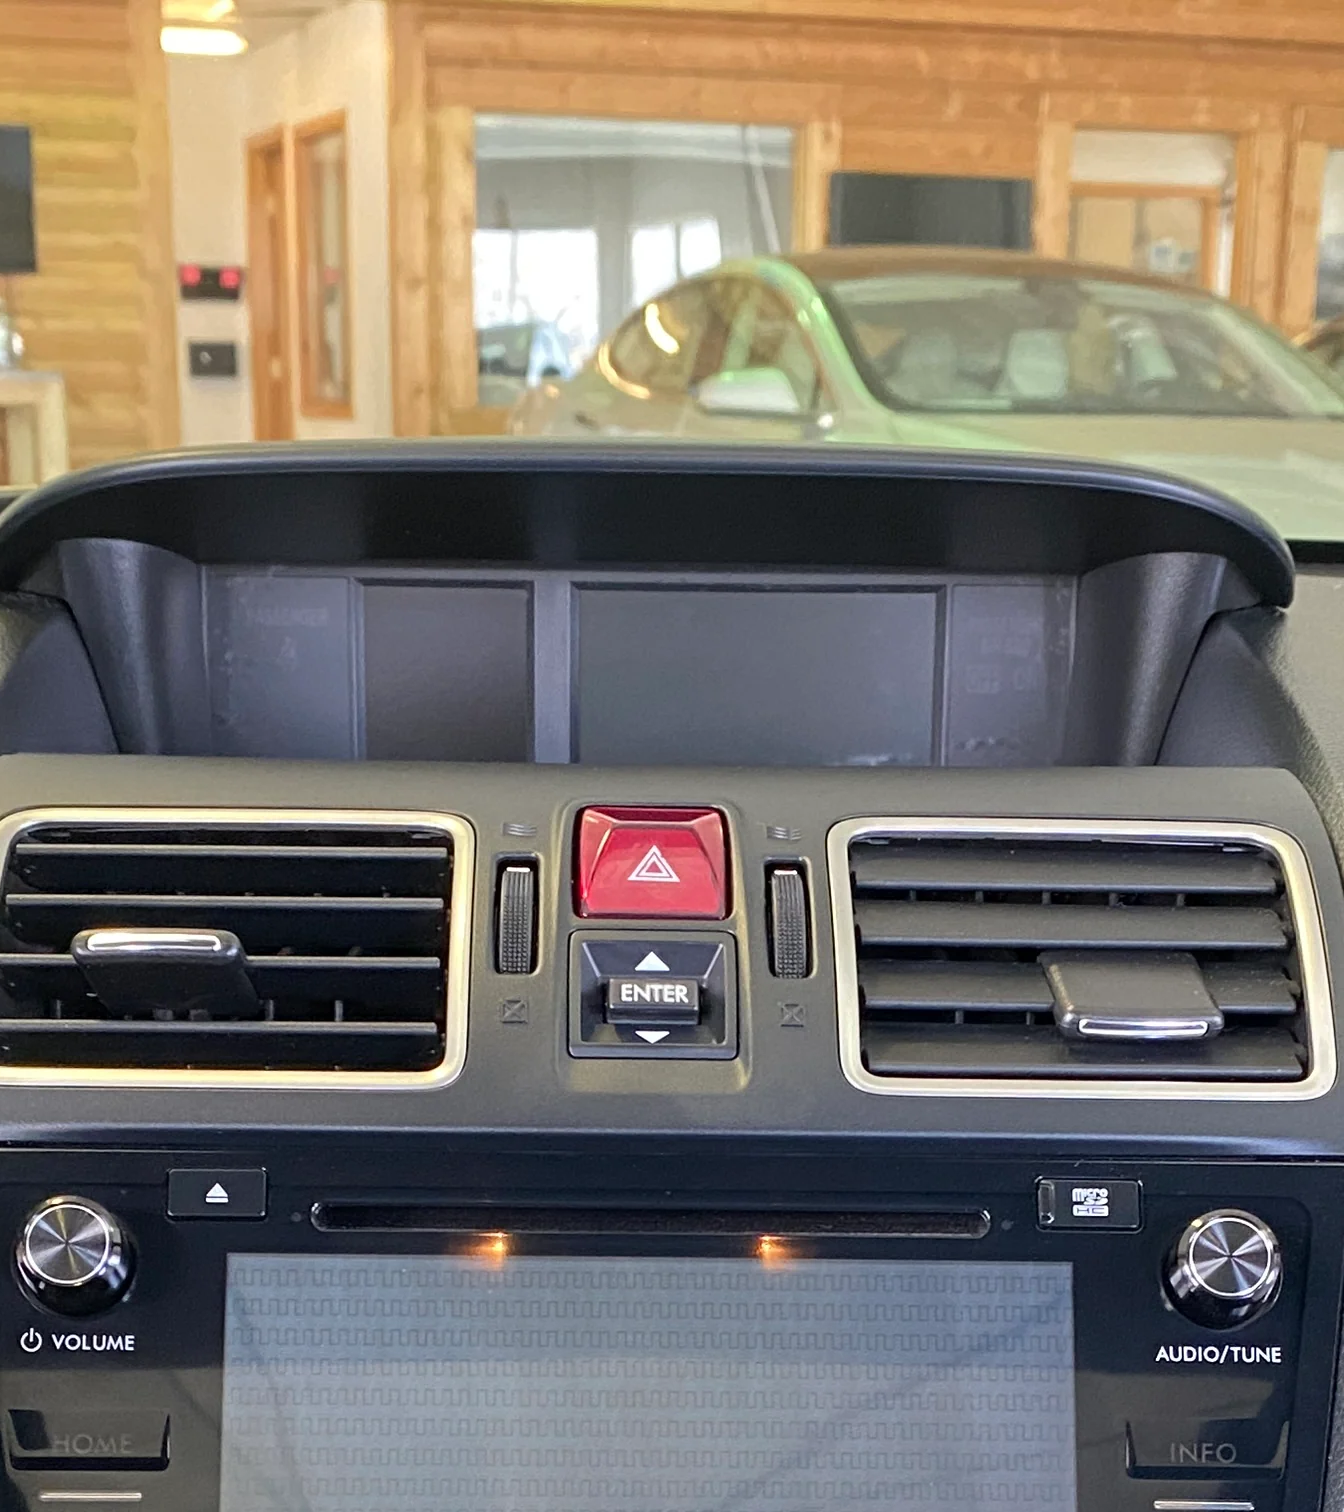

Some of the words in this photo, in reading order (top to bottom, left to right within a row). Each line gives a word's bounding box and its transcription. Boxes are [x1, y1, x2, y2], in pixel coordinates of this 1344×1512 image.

[620, 983, 689, 1003] ENTER
[51, 1333, 135, 1352] VOLUME
[1155, 1344, 1282, 1364] AUDIO/TUNE
[52, 1433, 134, 1455] HOME
[1170, 1442, 1237, 1464] INFO
